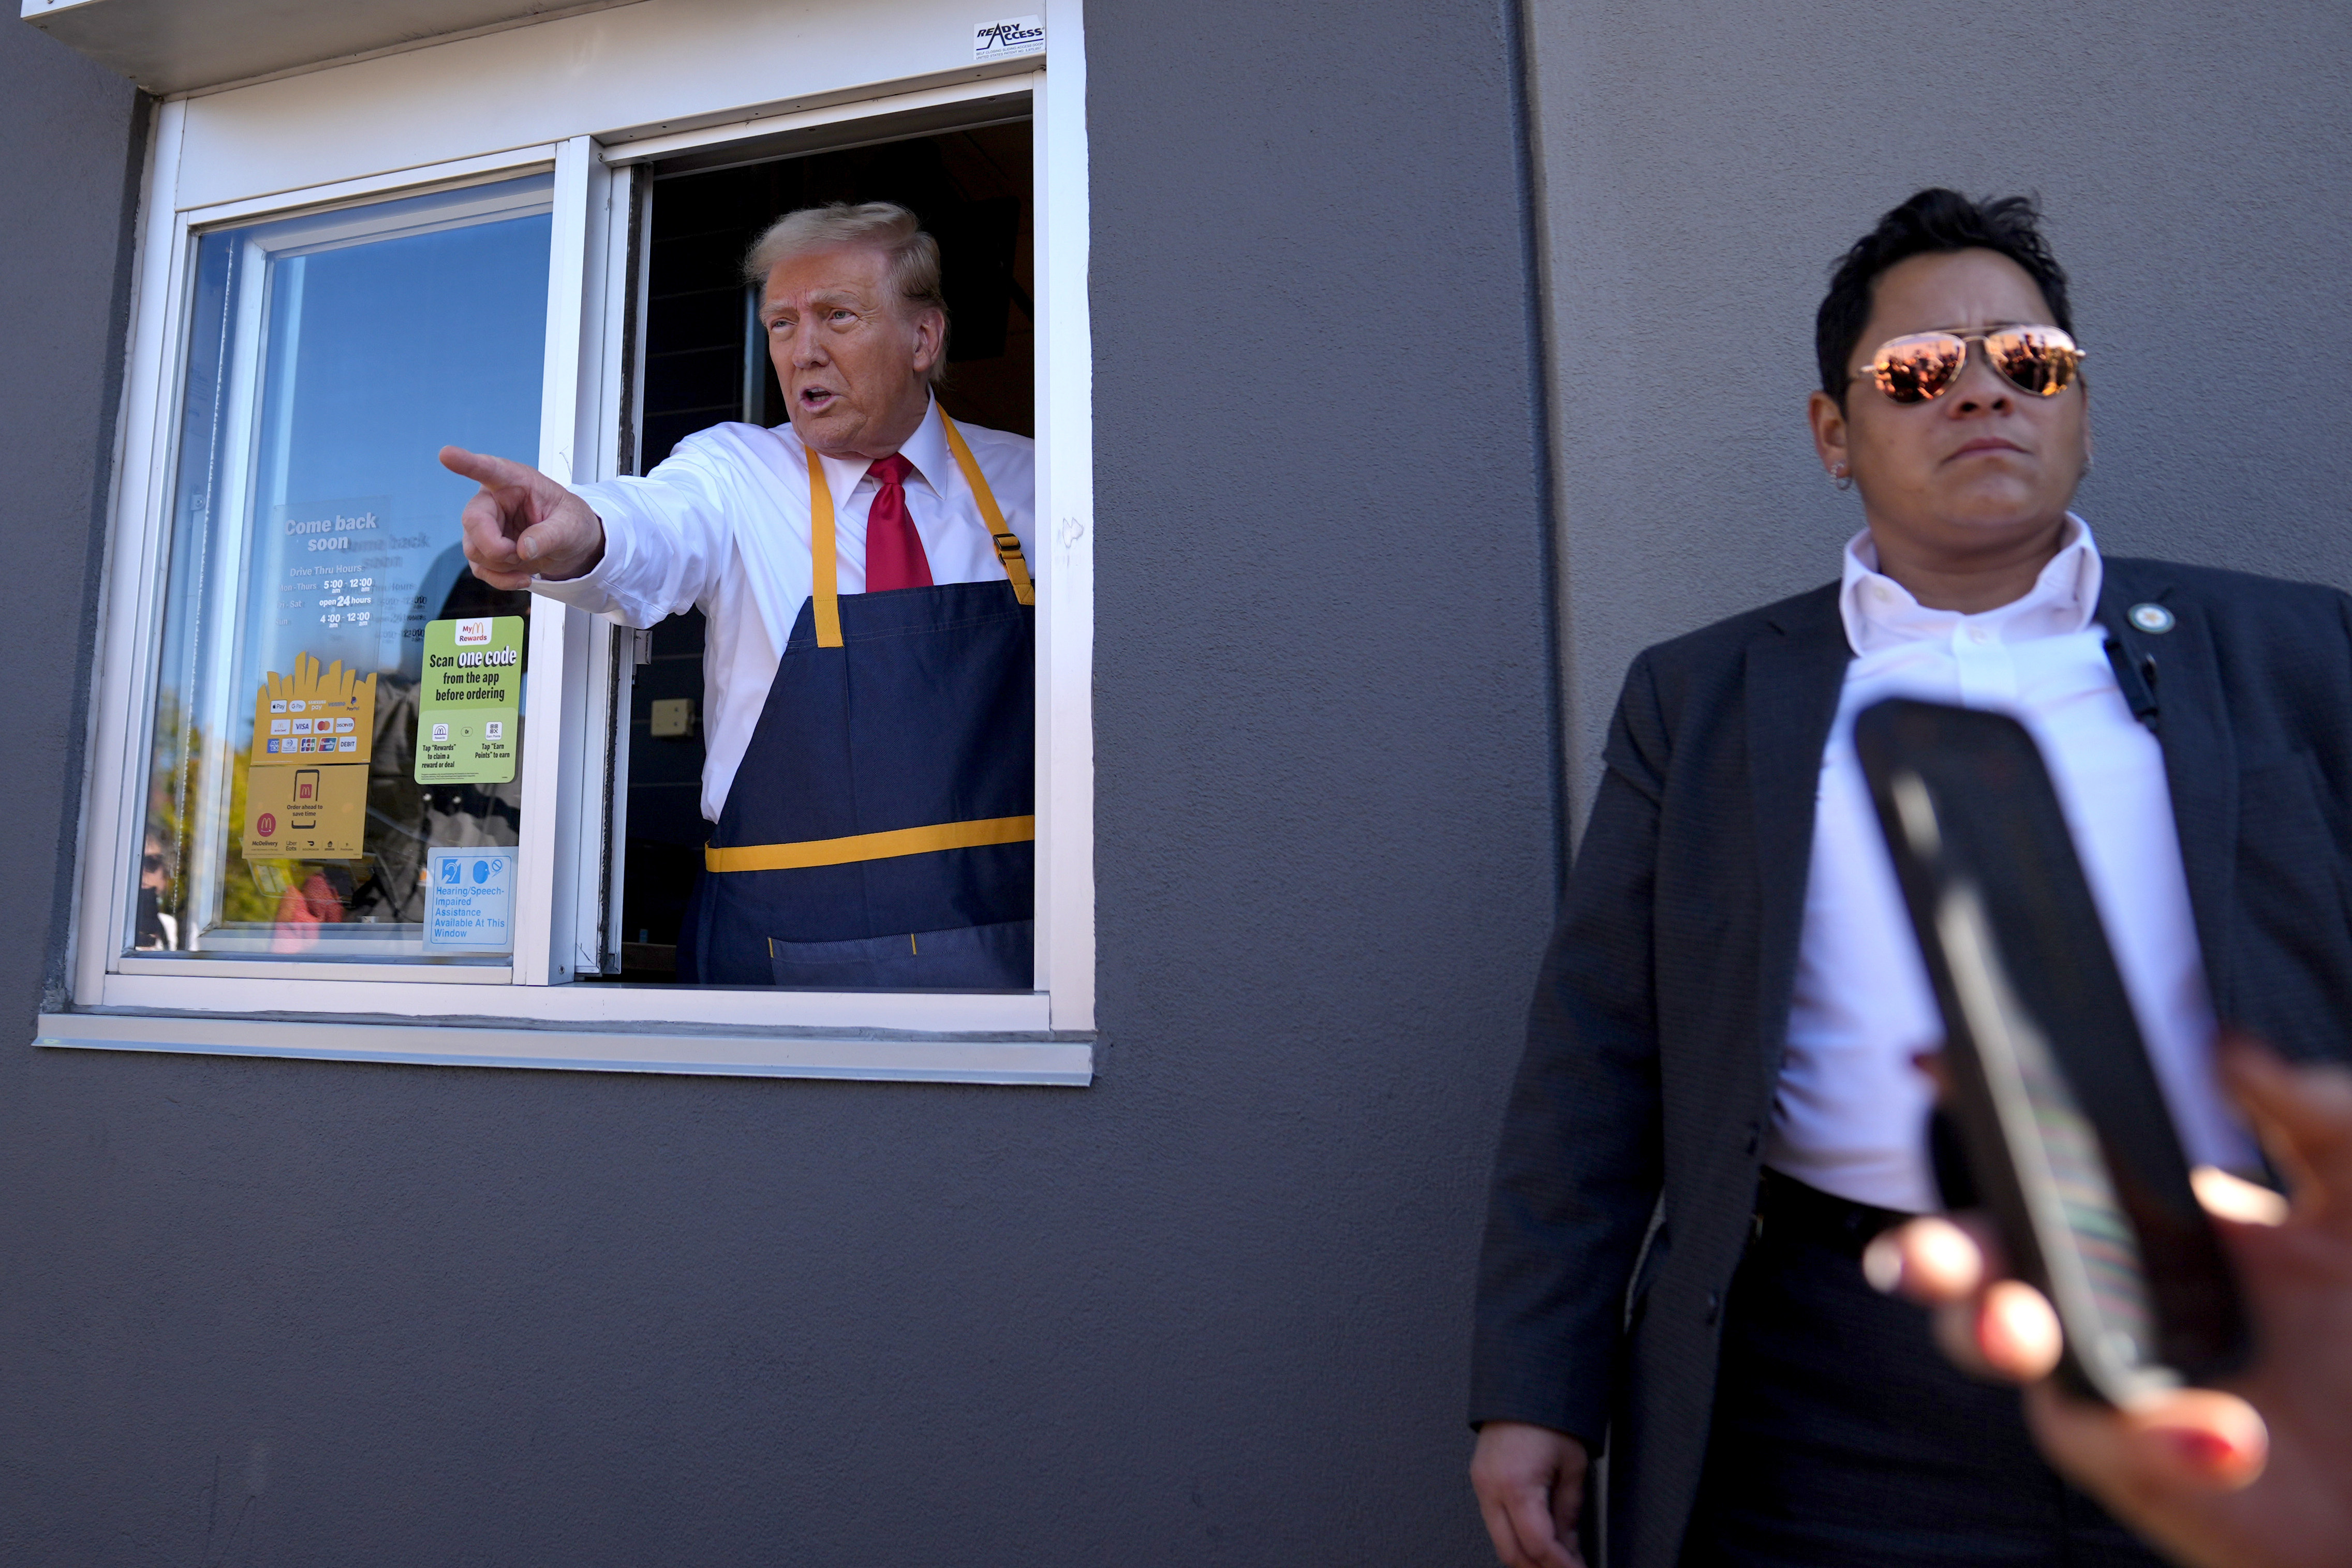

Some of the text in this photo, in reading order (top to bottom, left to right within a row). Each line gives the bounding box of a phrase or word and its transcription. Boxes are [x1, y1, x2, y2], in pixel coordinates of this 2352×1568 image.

[285, 512, 377, 535] Come back
[307, 537, 350, 551] soon
[290, 565, 362, 576] Drive Thru Hours
[323, 580, 343, 589] 5:00
[349, 578, 372, 587] 12:00
[319, 599, 336, 607] open
[337, 596, 350, 607] 24
[347, 612, 369, 622] 12:00
[430, 645, 517, 668] Scan one code
[443, 671, 499, 686] from the app
[436, 687, 505, 702] before ordering
[436, 886, 504, 897] Hearing/Speech-
[436, 897, 471, 907] Impaired
[435, 908, 481, 916] Assistance
[435, 919, 505, 927] Available At This
[435, 929, 467, 937] Window
